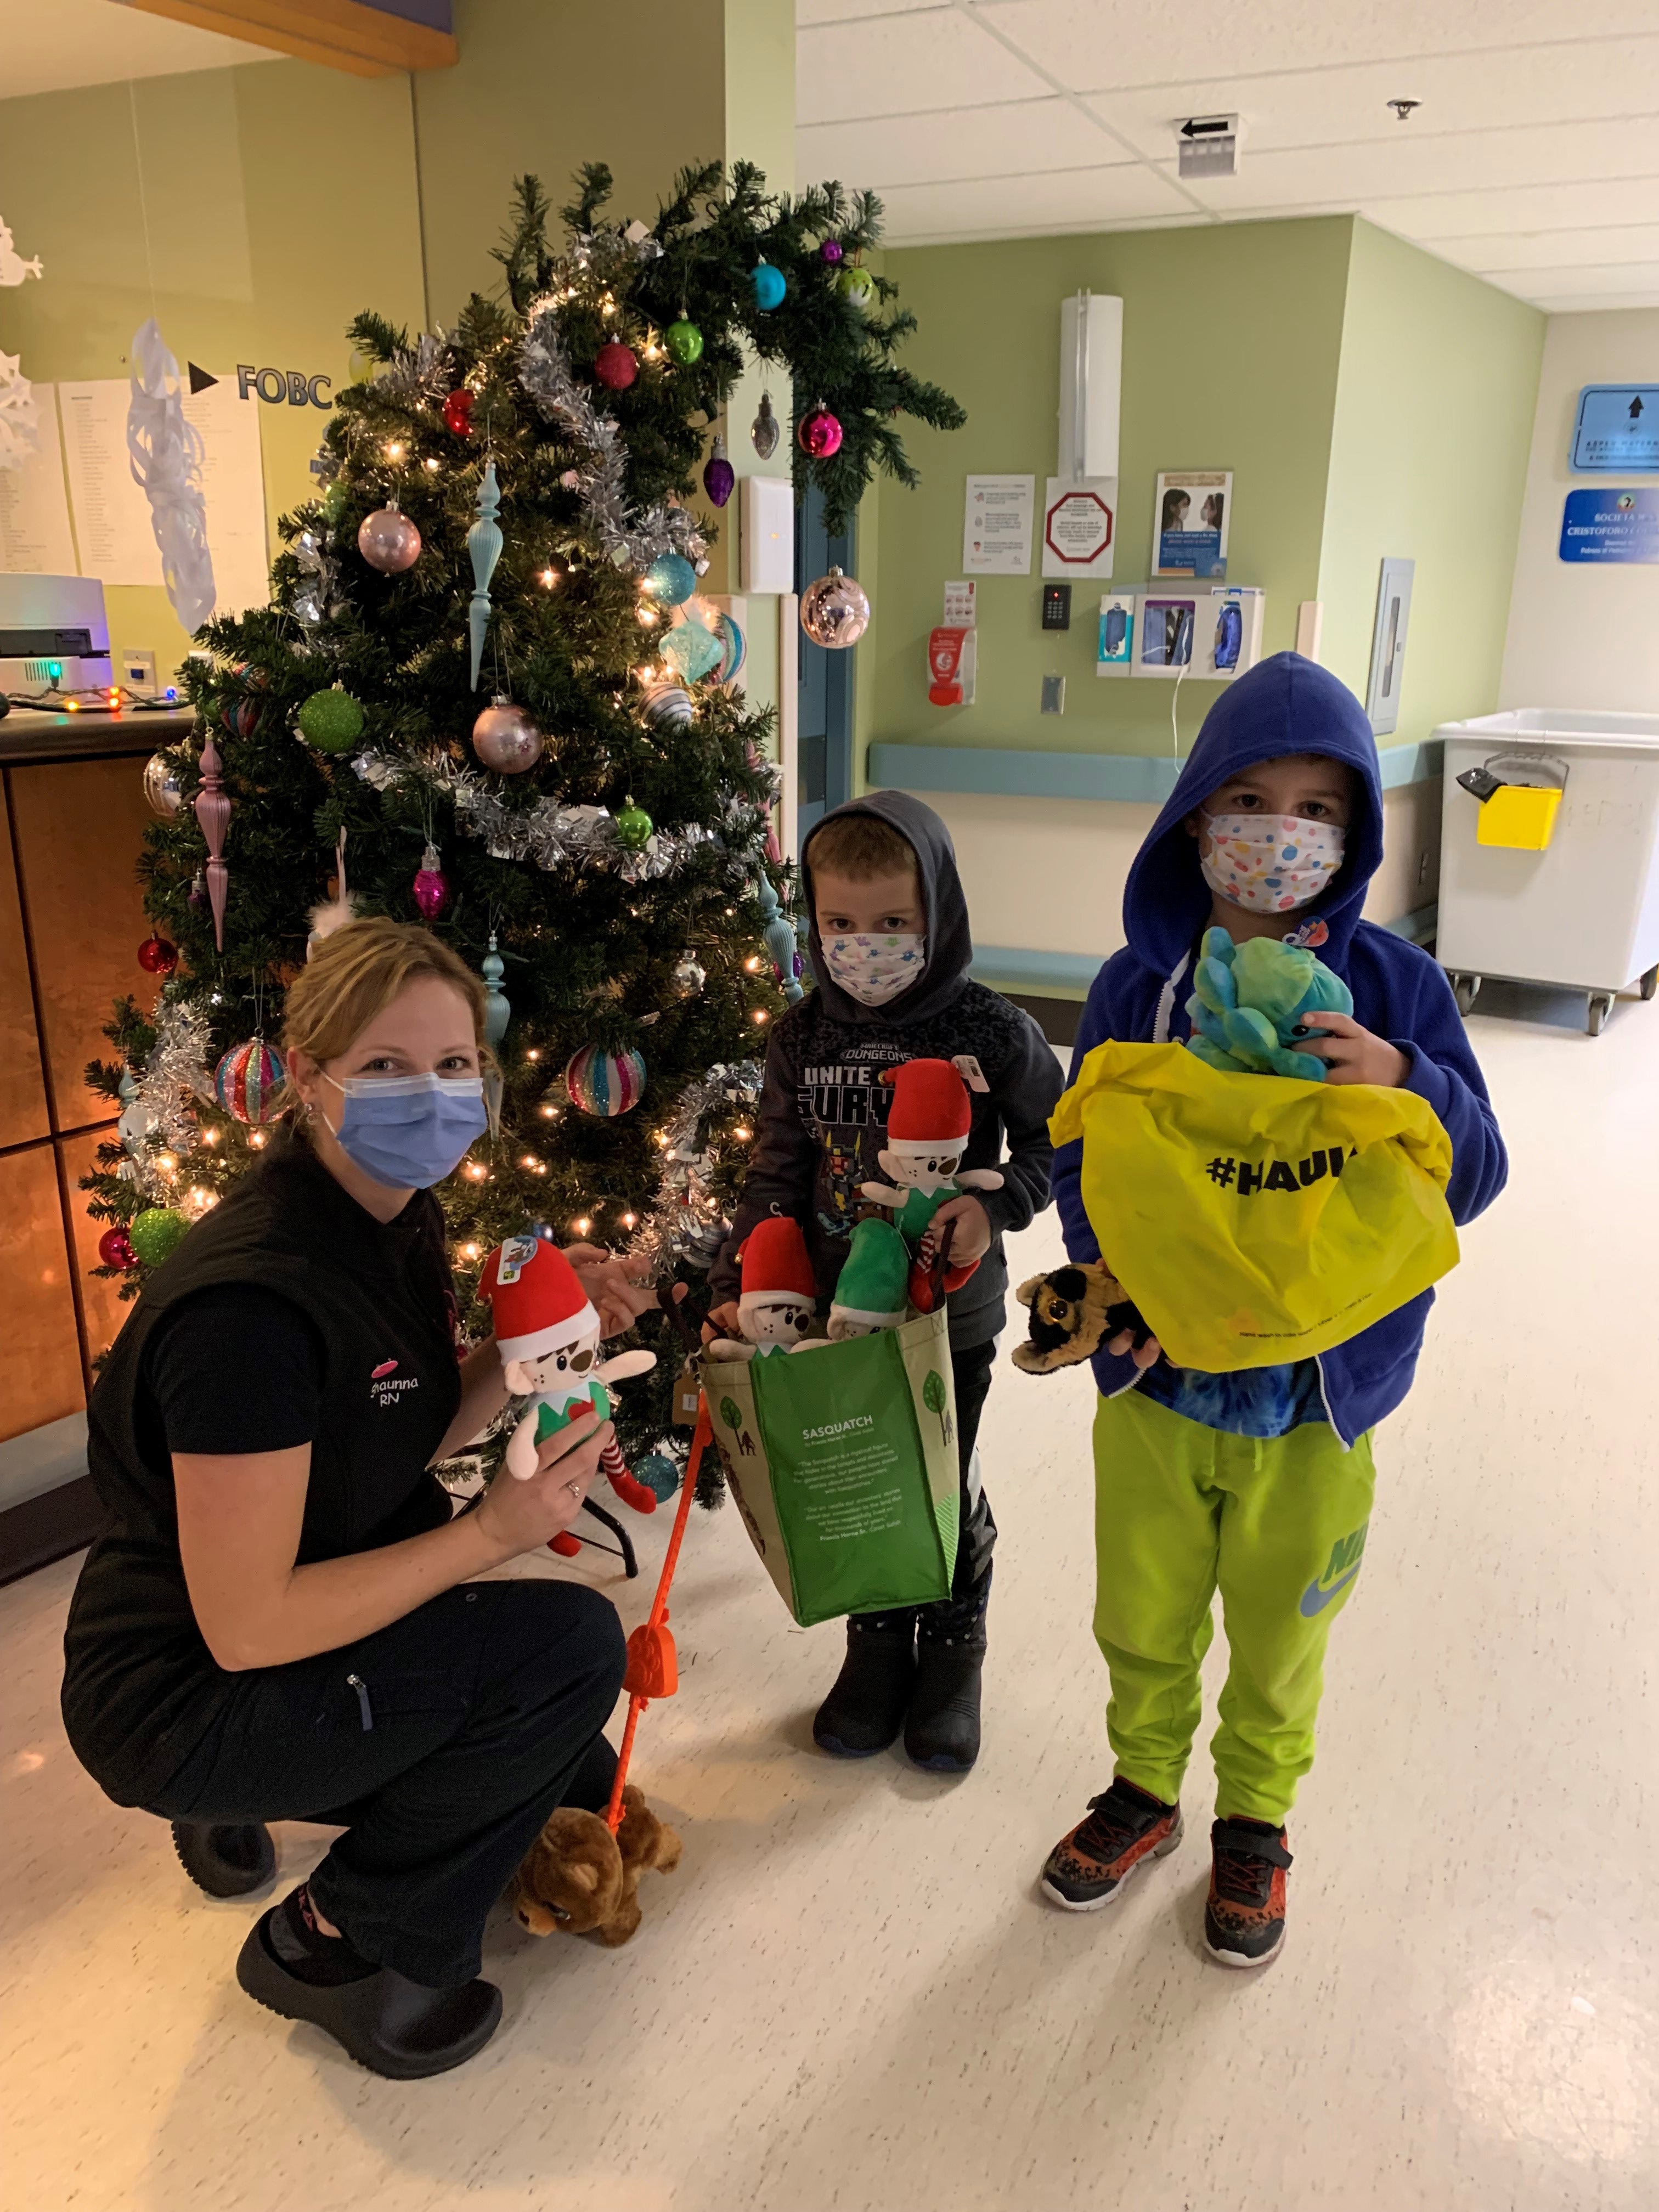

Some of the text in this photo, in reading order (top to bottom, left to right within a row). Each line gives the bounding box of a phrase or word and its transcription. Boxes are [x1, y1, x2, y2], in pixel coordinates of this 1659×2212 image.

[237, 364, 332, 410] FOBC
[845, 1049, 912, 1062] DUNGEONS
[805, 1066, 871, 1085] UNITE
[380, 1392, 399, 1407] RN
[803, 1415, 873, 1440] SASQUATCH
